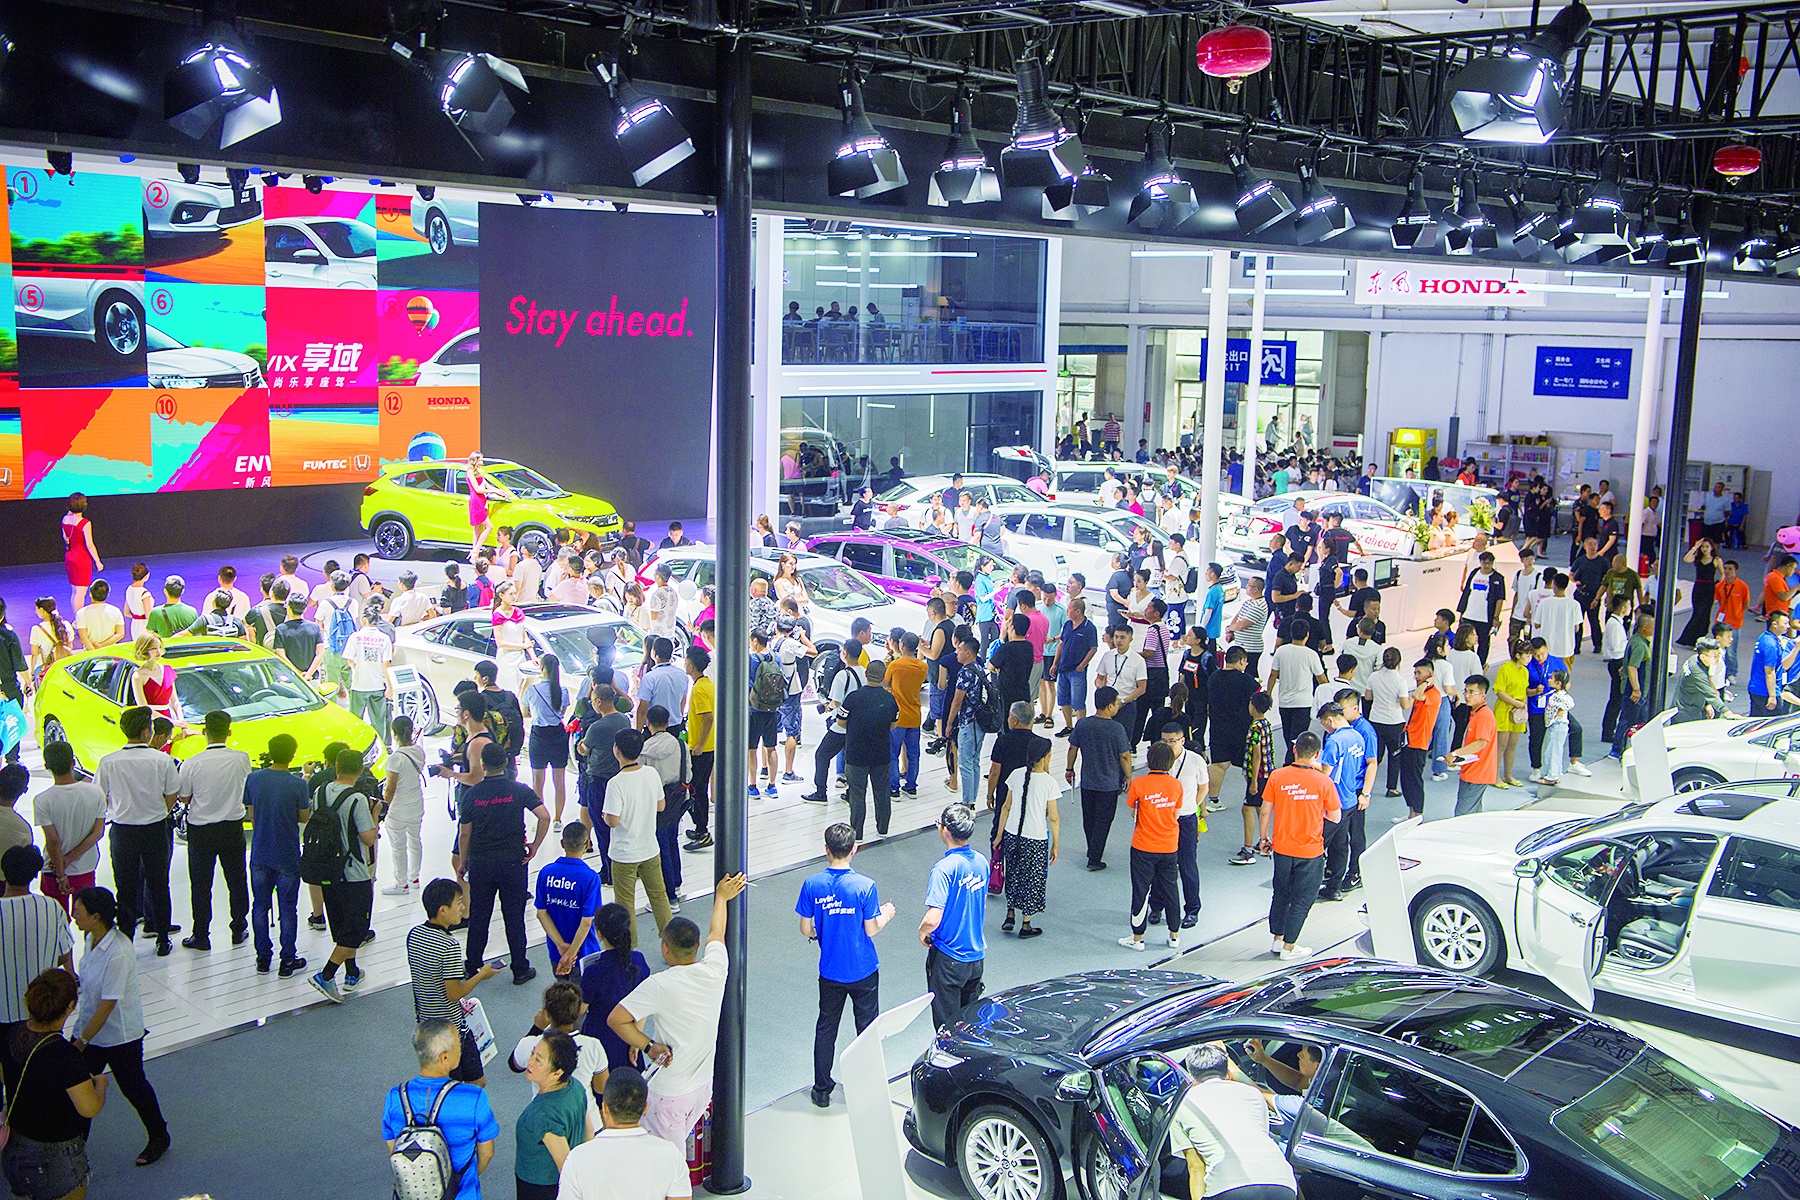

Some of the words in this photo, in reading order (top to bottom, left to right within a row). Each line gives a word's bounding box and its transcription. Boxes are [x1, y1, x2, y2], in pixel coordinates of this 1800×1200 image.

[505, 294, 580, 347] Stay
[583, 294, 694, 338] ahead.
[301, 342, 363, 372] 享域
[427, 397, 471, 405] HONDA
[303, 459, 347, 471] FUNTEC
[474, 799, 490, 807] Stay
[546, 875, 577, 891] Haier
